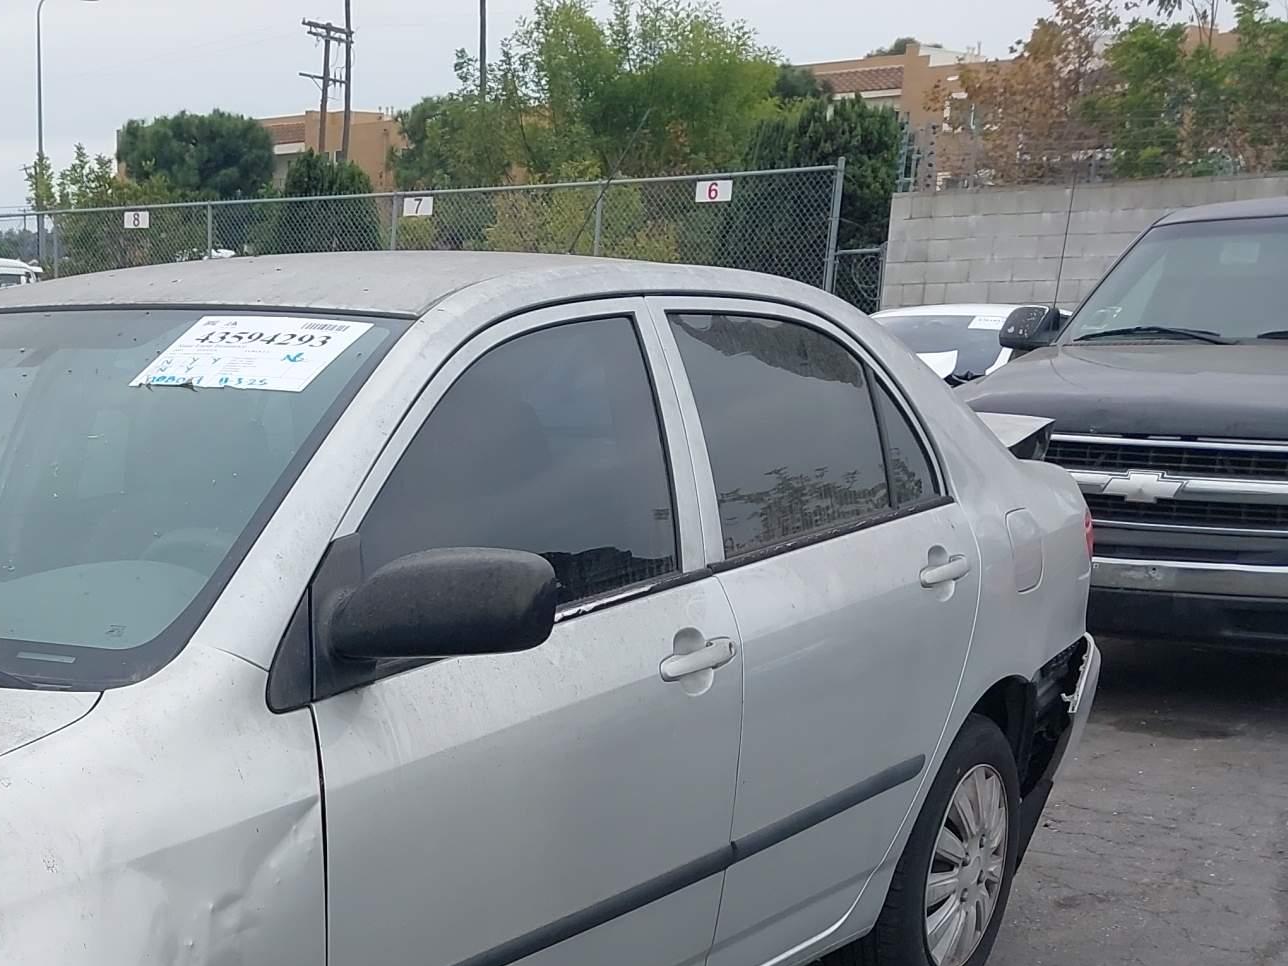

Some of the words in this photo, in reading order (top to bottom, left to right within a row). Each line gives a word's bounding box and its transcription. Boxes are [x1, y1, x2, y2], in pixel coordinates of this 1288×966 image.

[708, 182, 719, 200] 6
[413, 198, 423, 215] 7
[132, 212, 141, 228] 8
[195, 331, 333, 348] 43594293
